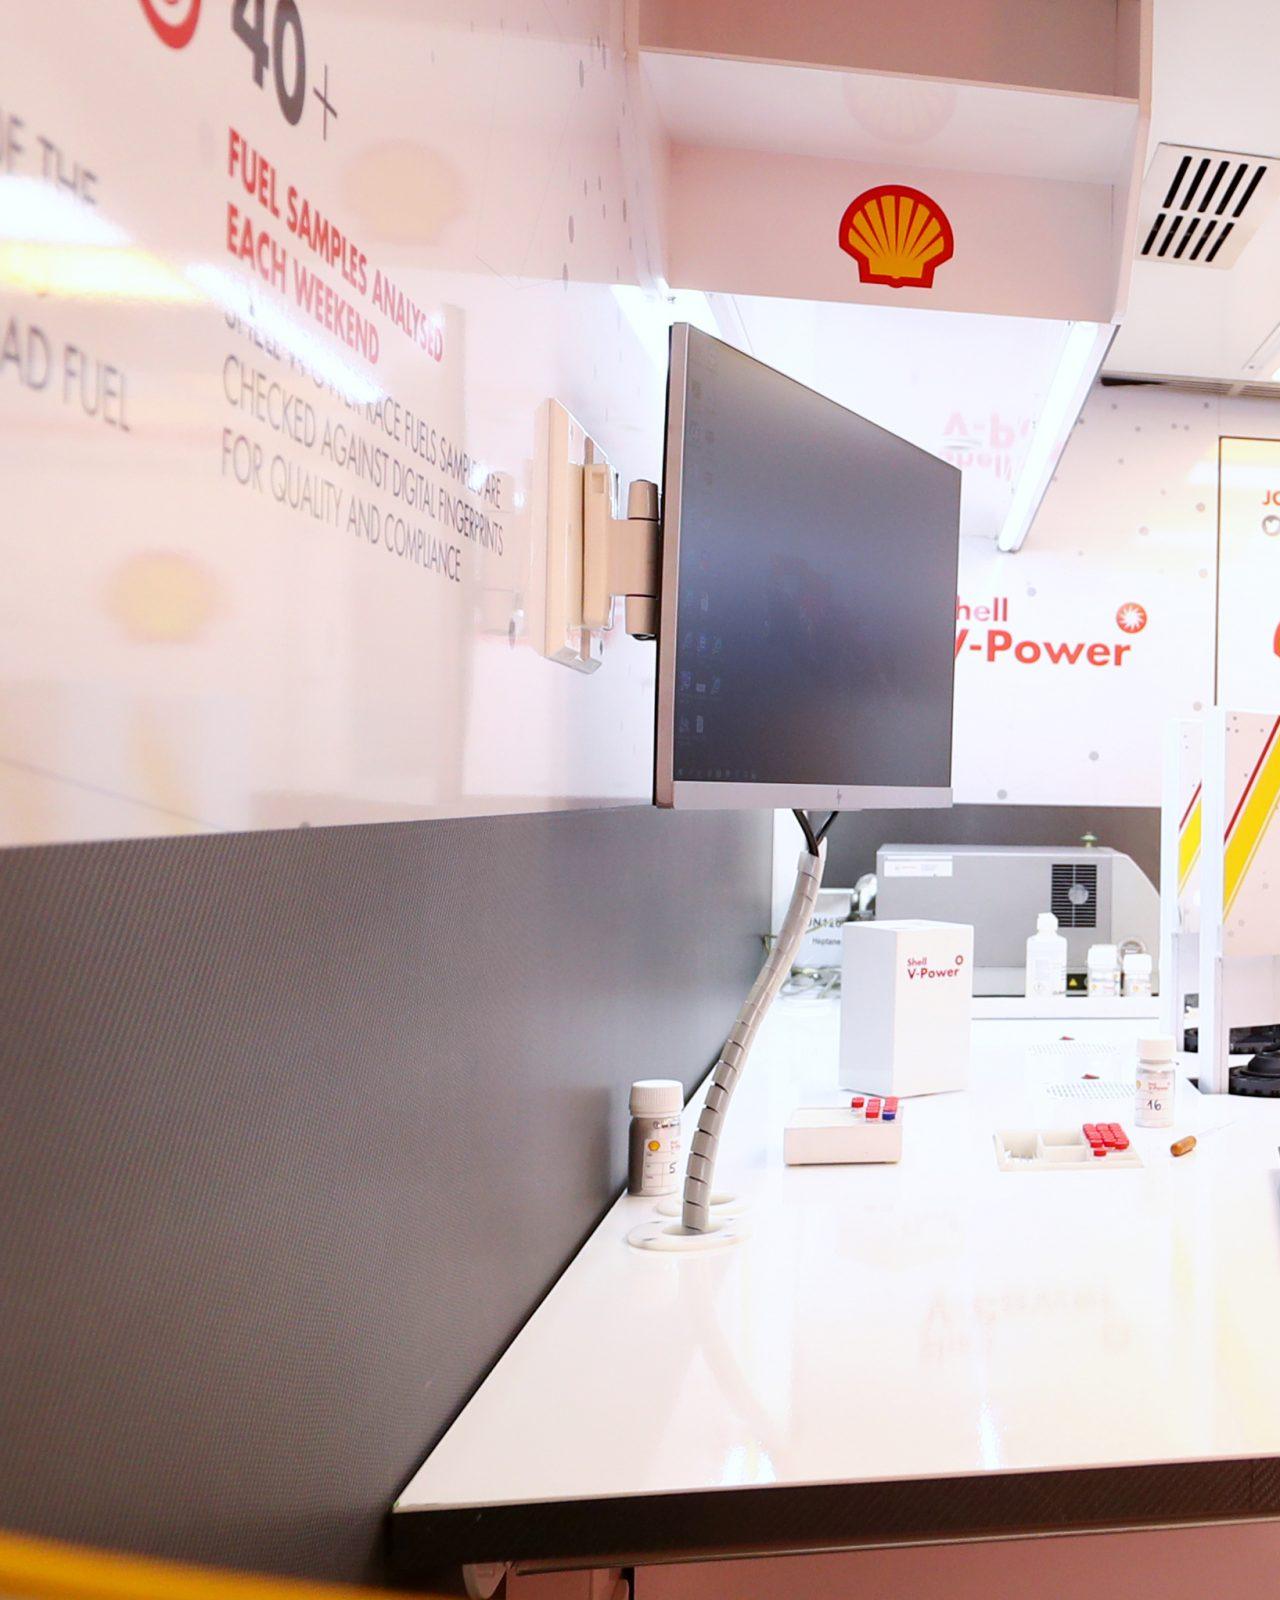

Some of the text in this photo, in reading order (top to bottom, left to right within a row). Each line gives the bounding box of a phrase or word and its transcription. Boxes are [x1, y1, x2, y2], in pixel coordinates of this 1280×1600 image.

[231, 0, 338, 141] 40+
[226, 201, 287, 294] EACH
[293, 256, 380, 365] WEEKEND
[227, 126, 280, 220] FUEL
[286, 184, 368, 297] SAMPLES
[372, 268, 444, 363] ANALYSED
[62, 342, 131, 434] FUEL
[221, 426, 462, 583] FOR QUALITY AND COMPLIANCE
[222, 354, 316, 448] CHECKED
[320, 417, 390, 491] AGAINST
[392, 459, 436, 519] DIGITAL
[438, 487, 504, 557] FINGERPRINTS
[405, 410, 437, 466] FUELS
[439, 437, 484, 496] SAMPL
[483, 472, 501, 510] ARE
[956, 595, 1009, 623] hell
[906, 956, 928, 967] Shell
[907, 967, 960, 980] V-Power
[1147, 1099, 1162, 1111] 16
